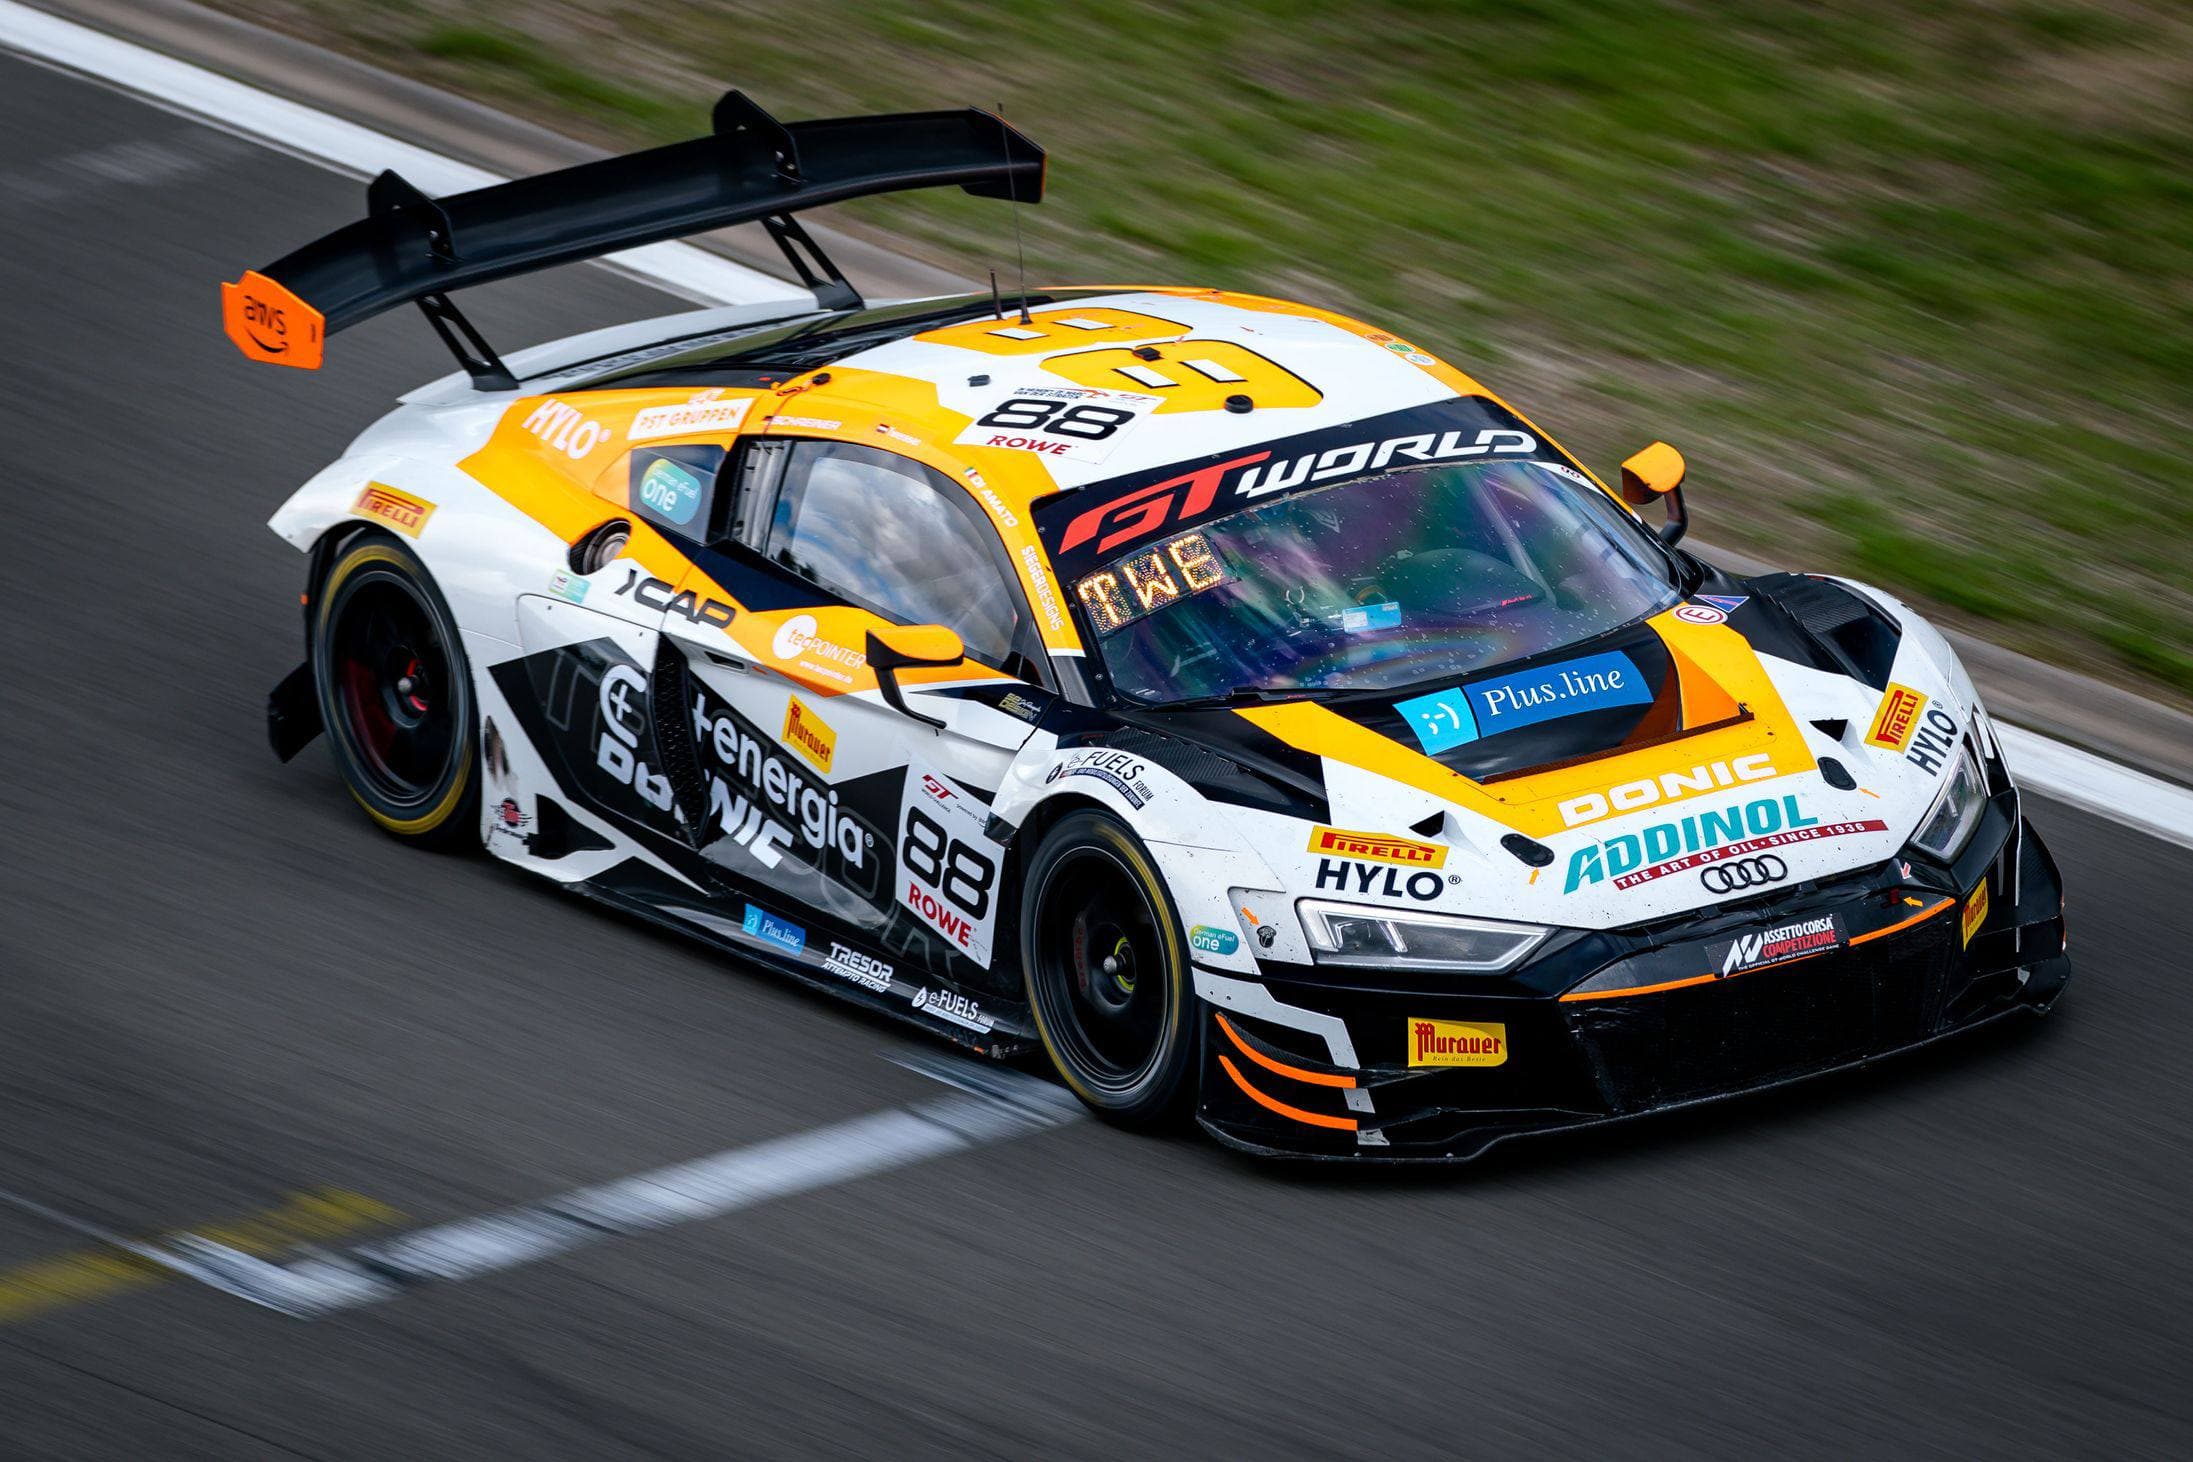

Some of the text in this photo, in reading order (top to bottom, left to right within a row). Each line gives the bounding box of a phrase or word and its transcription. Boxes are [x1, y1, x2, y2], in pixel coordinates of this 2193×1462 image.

[977, 398, 1136, 441] 88
[986, 434, 1072, 455] ROWE
[357, 488, 425, 528] PIRELLI
[643, 478, 677, 511] one
[969, 475, 1018, 527] DI AMATO
[1059, 429, 1537, 555] GT WORLD
[1482, 667, 1625, 718] Plus.line
[1875, 690, 1919, 746] PIRELLI
[922, 774, 959, 799] GT
[1557, 753, 1777, 828] DONIC
[903, 806, 995, 921] 88
[1320, 832, 1436, 862] PIRELLI
[1563, 795, 1818, 895] ADDINOL
[1617, 822, 1865, 889] THE ART OF OIL SINCE 1936
[909, 881, 972, 948] ROWE
[1763, 917, 1834, 945] ASSETTO CORSA
[830, 941, 894, 983] TRESOR
[1193, 935, 1220, 951] one
[1762, 930, 1837, 958] COMPETIZIONE
[857, 978, 887, 994] RACING
[929, 989, 979, 1020] e-FUELS
[1415, 1022, 1502, 1062] Murauer
